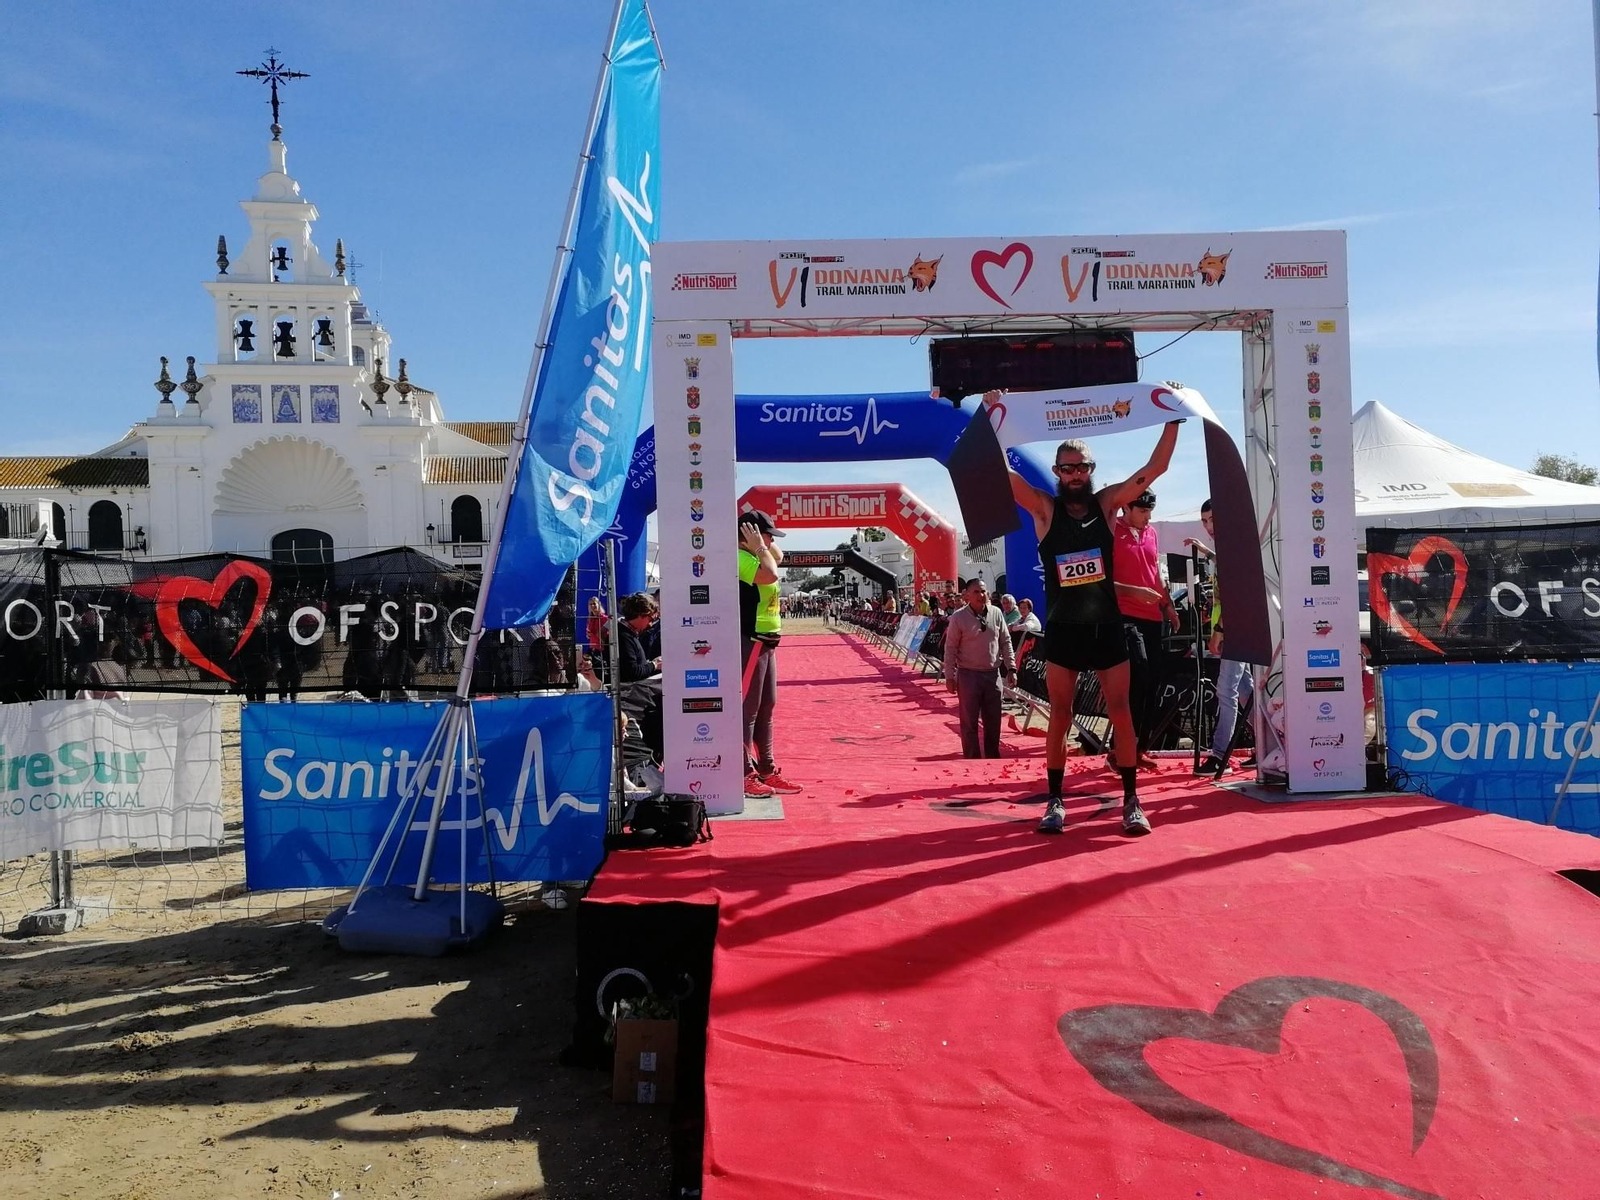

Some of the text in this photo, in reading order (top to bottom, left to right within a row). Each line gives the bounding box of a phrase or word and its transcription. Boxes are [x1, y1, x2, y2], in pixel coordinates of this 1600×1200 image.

[814, 267, 905, 285] DOÑANA
[1061, 255, 1101, 302] VI
[1106, 262, 1194, 280] DOÑANA
[1274, 263, 1329, 279] NutriSport
[682, 274, 738, 290] NutriSport
[768, 259, 809, 309] VI
[816, 284, 906, 296] TRAIL MARATHON
[1107, 279, 1196, 291] TRAIL MARATHON
[548, 252, 632, 527] Sanitas
[759, 402, 854, 423] Sanitas
[1048, 419, 1069, 428] TRAIL
[1070, 414, 1113, 425] MARATHON
[1382, 483, 1427, 492] IMD
[789, 493, 887, 518] NutriSport
[1064, 561, 1097, 578] 208
[1490, 577, 1600, 618] OFS
[5, 599, 112, 646] ORT
[1401, 708, 1600, 761] Sanita
[259, 747, 486, 800] Sanitas
[30, 791, 145, 811] COMERCIAL
